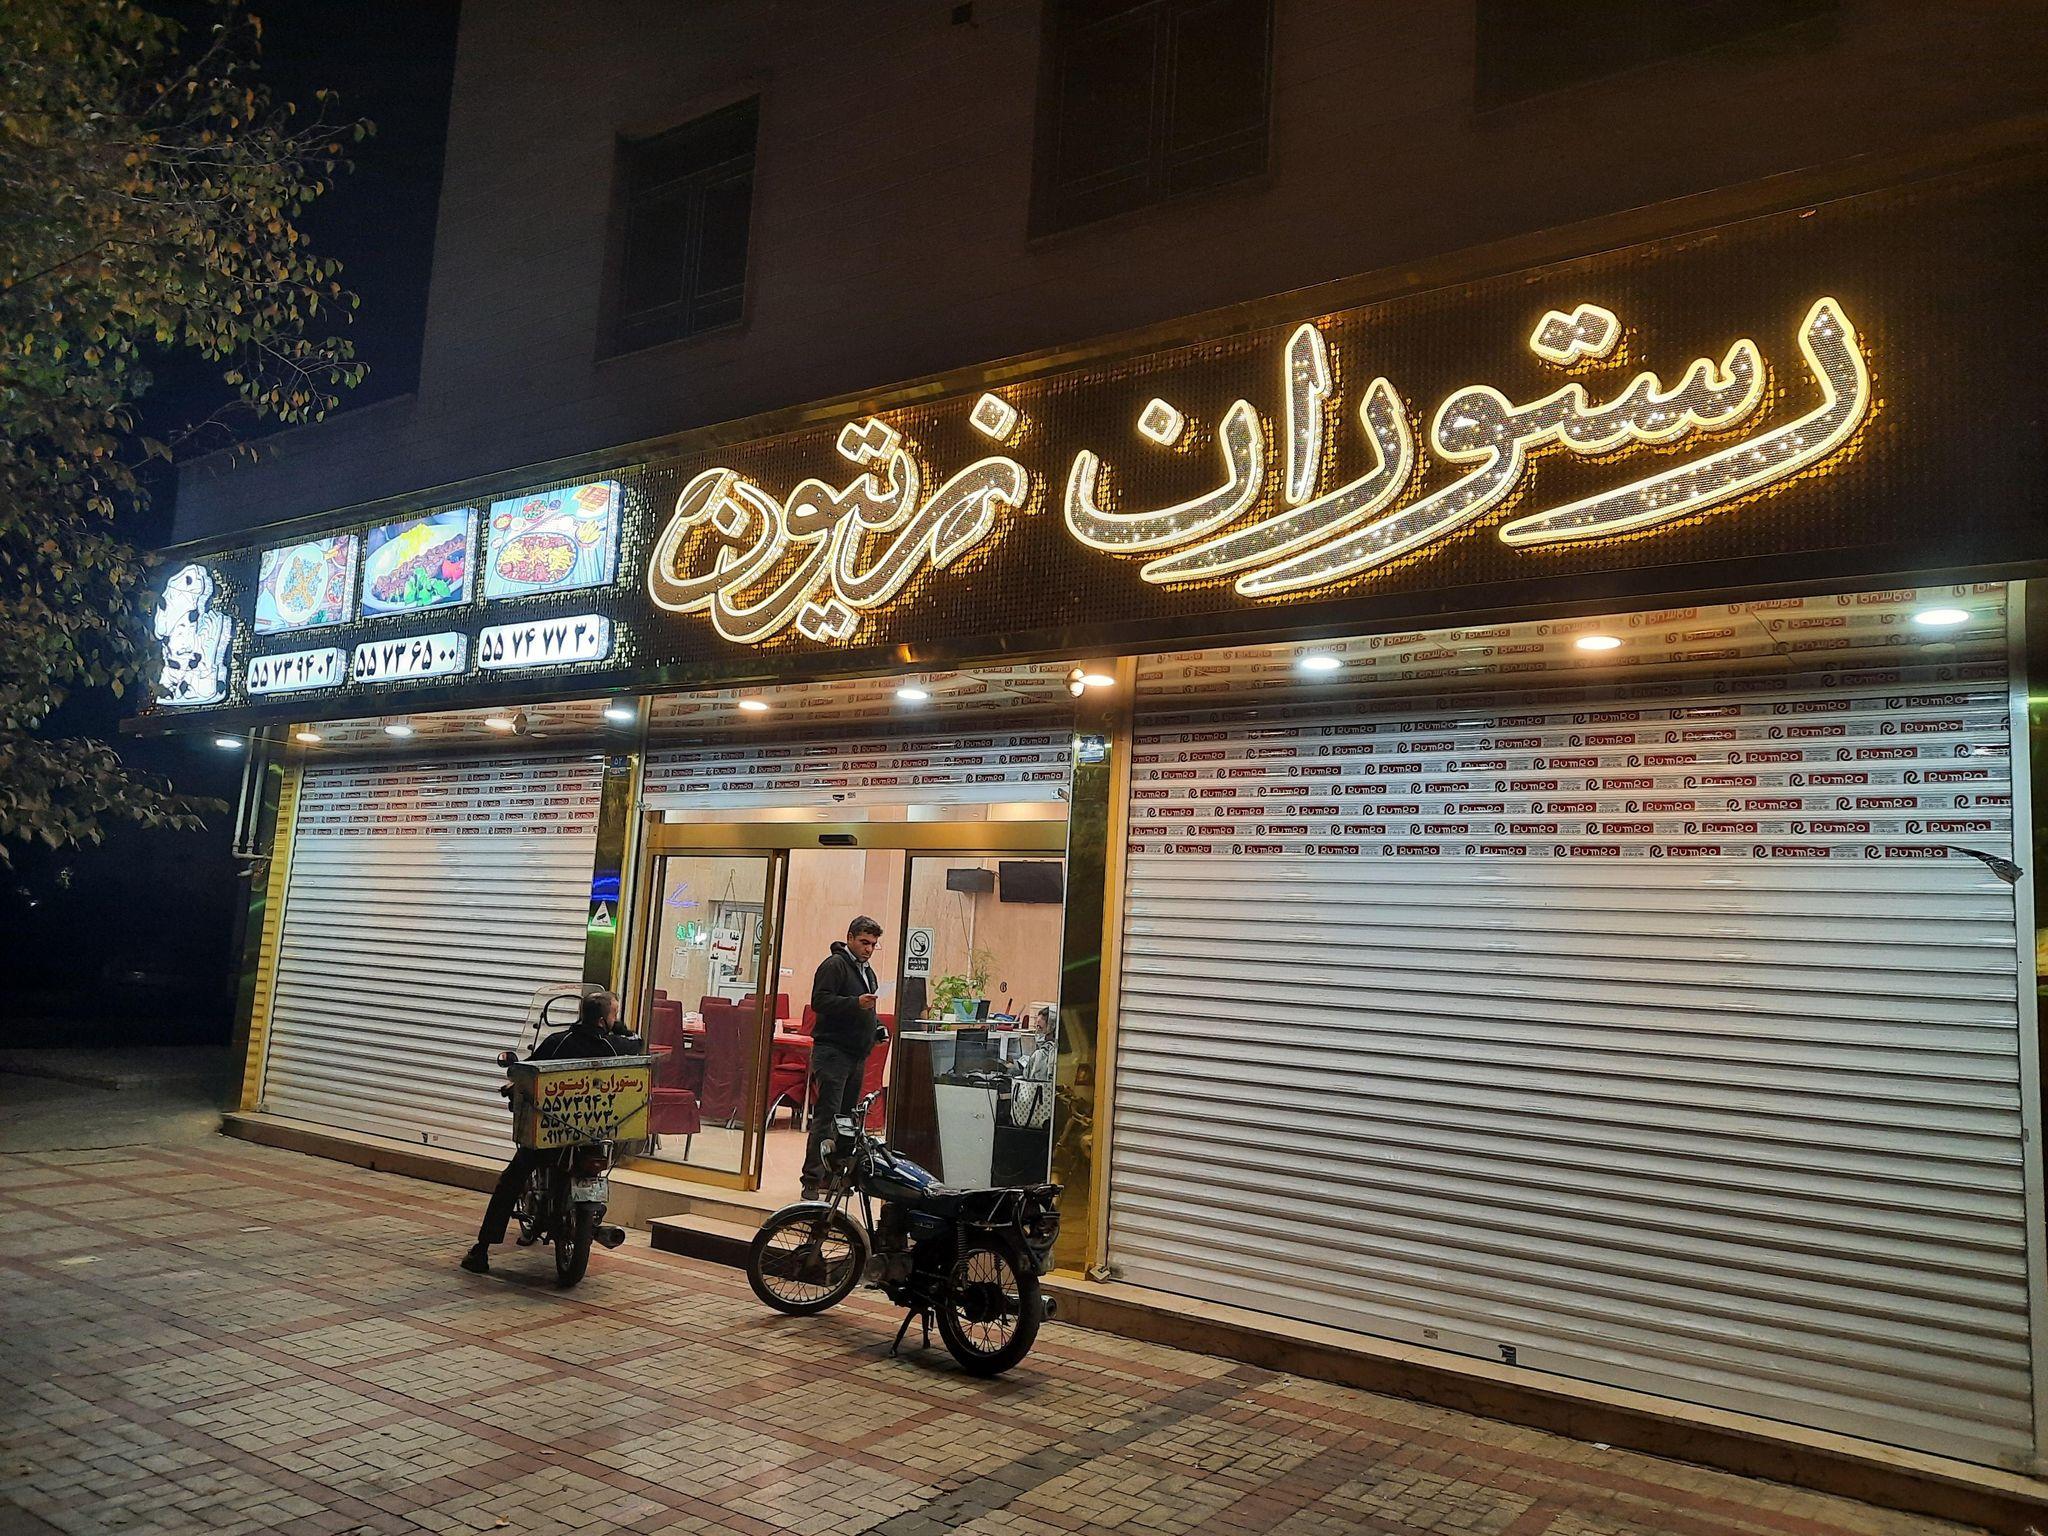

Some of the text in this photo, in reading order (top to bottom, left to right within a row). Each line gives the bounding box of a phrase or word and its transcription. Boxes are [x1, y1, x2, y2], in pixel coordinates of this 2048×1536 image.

[648, 297, 1870, 646] رستوران زیتون
[545, 1074, 643, 1096] رستوران زیتون
[543, 1094, 616, 1112] ۵۵۷۳۹۴۰۲
